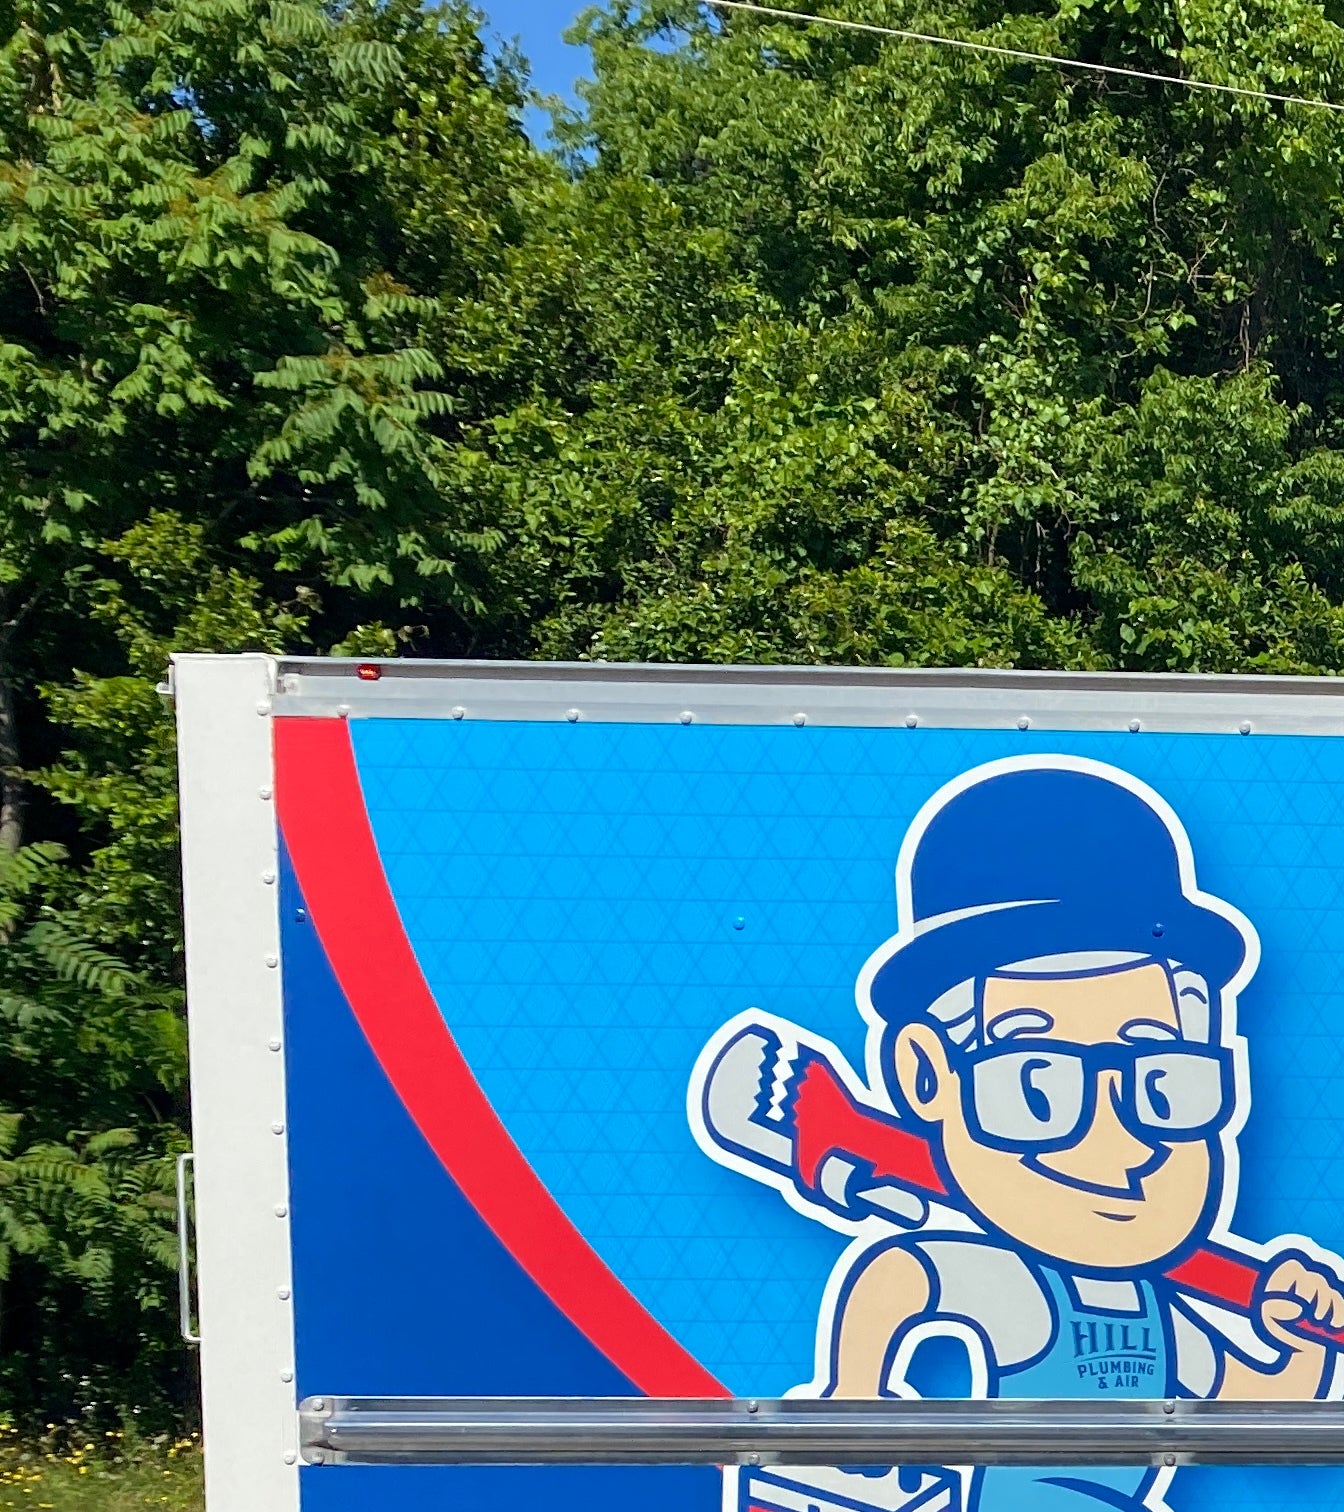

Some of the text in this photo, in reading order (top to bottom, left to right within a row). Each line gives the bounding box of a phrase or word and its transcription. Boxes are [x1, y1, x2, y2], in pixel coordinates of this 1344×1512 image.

[1070, 1321, 1157, 1358] HILL
[1077, 1361, 1155, 1379] PLUMBING
[1098, 1375, 1140, 1389] & AIR
